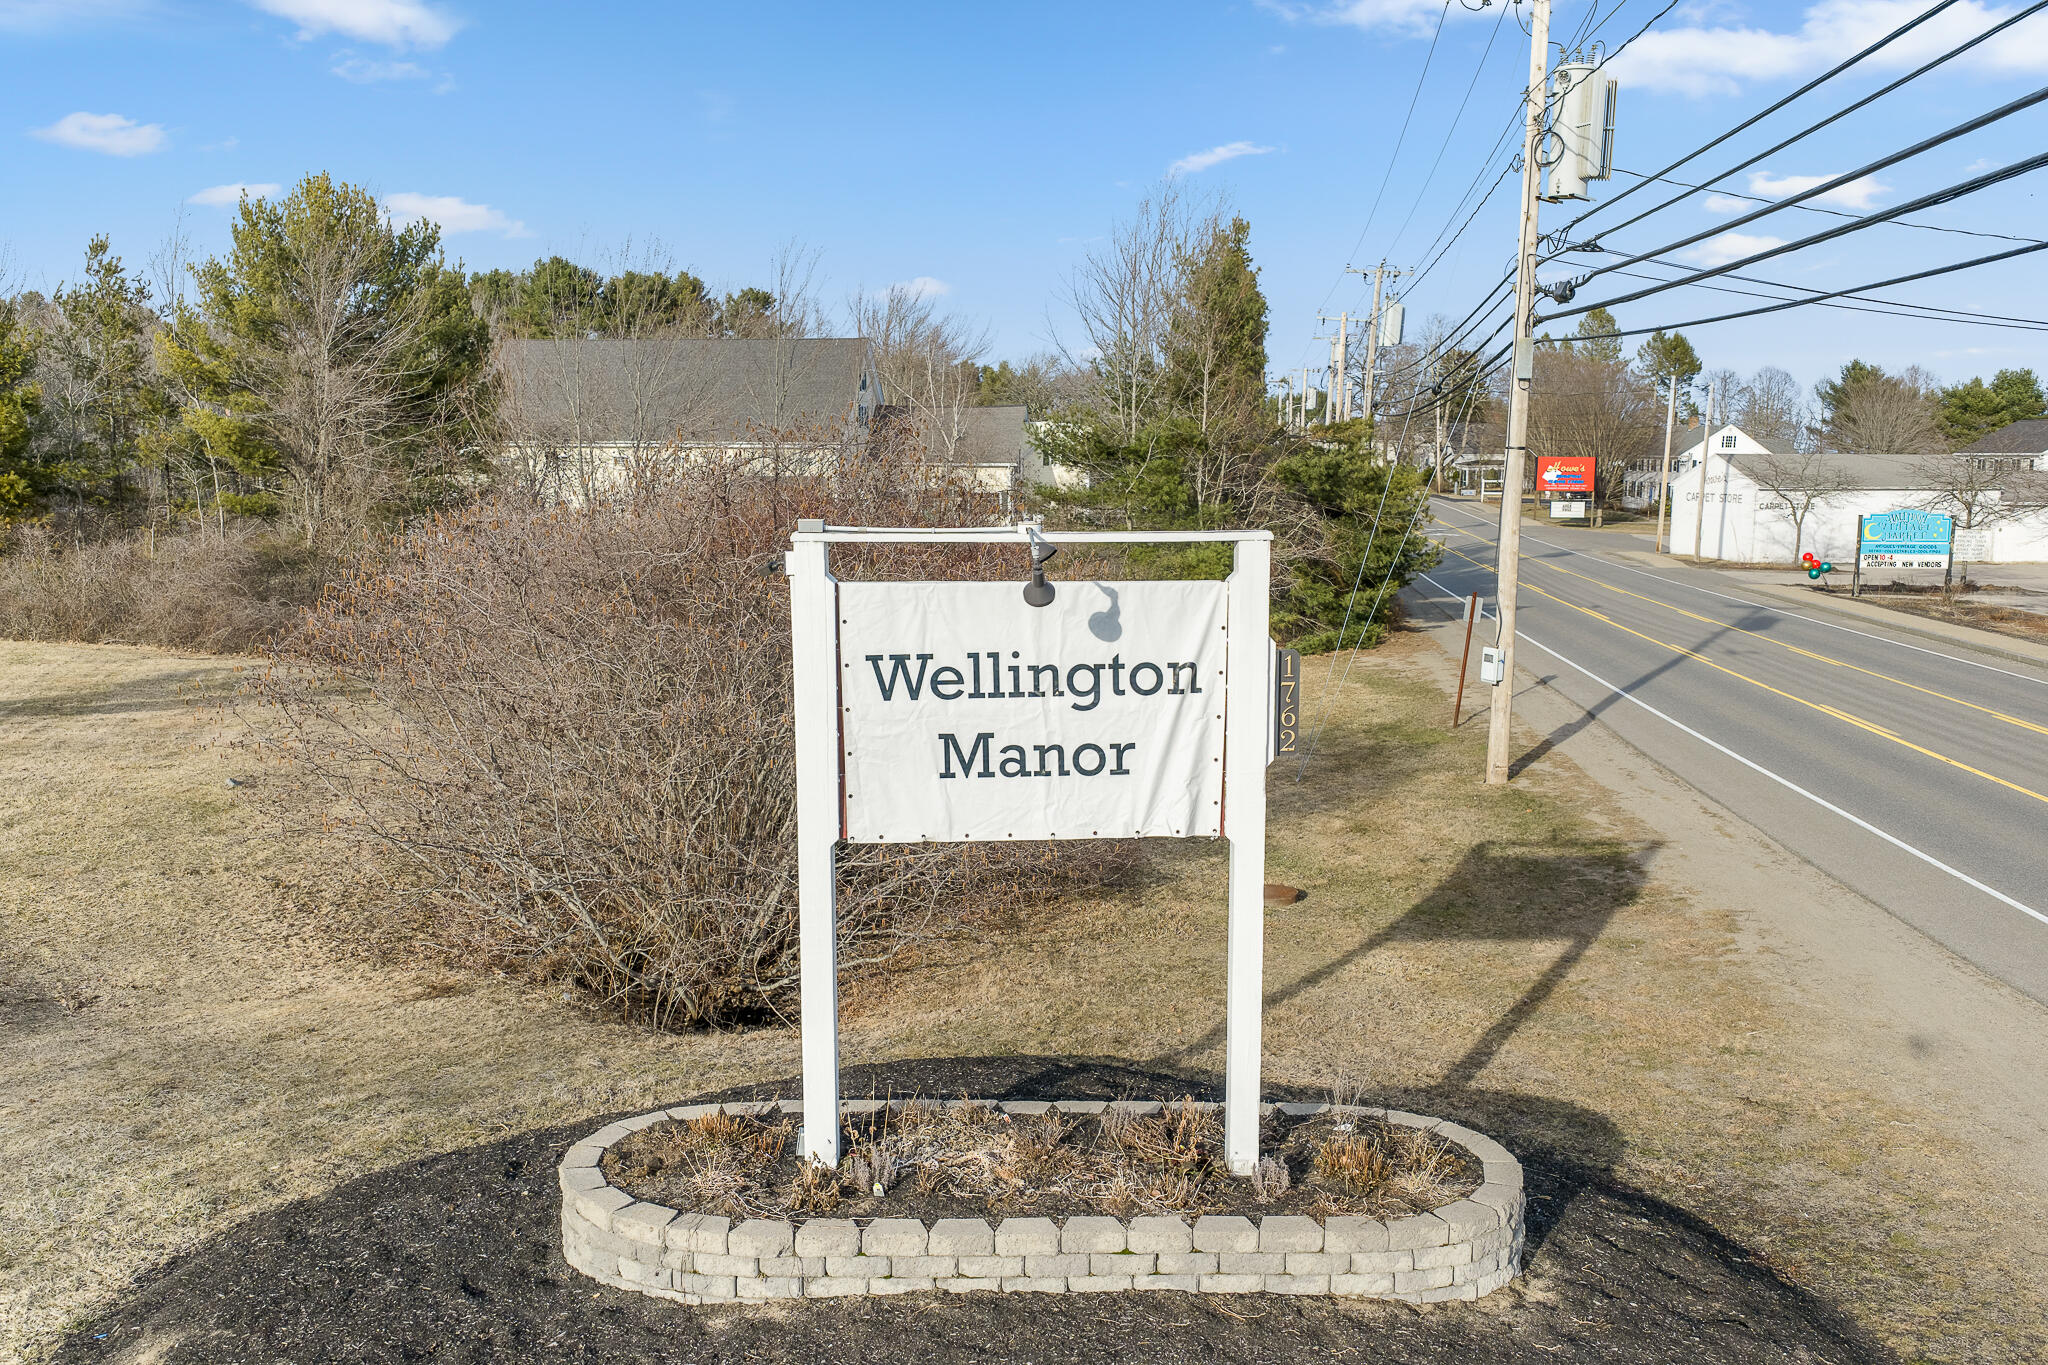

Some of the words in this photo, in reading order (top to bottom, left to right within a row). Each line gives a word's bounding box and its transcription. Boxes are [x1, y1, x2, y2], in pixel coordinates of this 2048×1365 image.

[1546, 461, 1585, 473] Howe's
[1719, 493, 1743, 504] STORE
[1759, 502, 1788, 510] CARPET
[865, 651, 1202, 712] Wellington
[1280, 654, 1297, 752] 1762
[938, 732, 1136, 779] Manor
